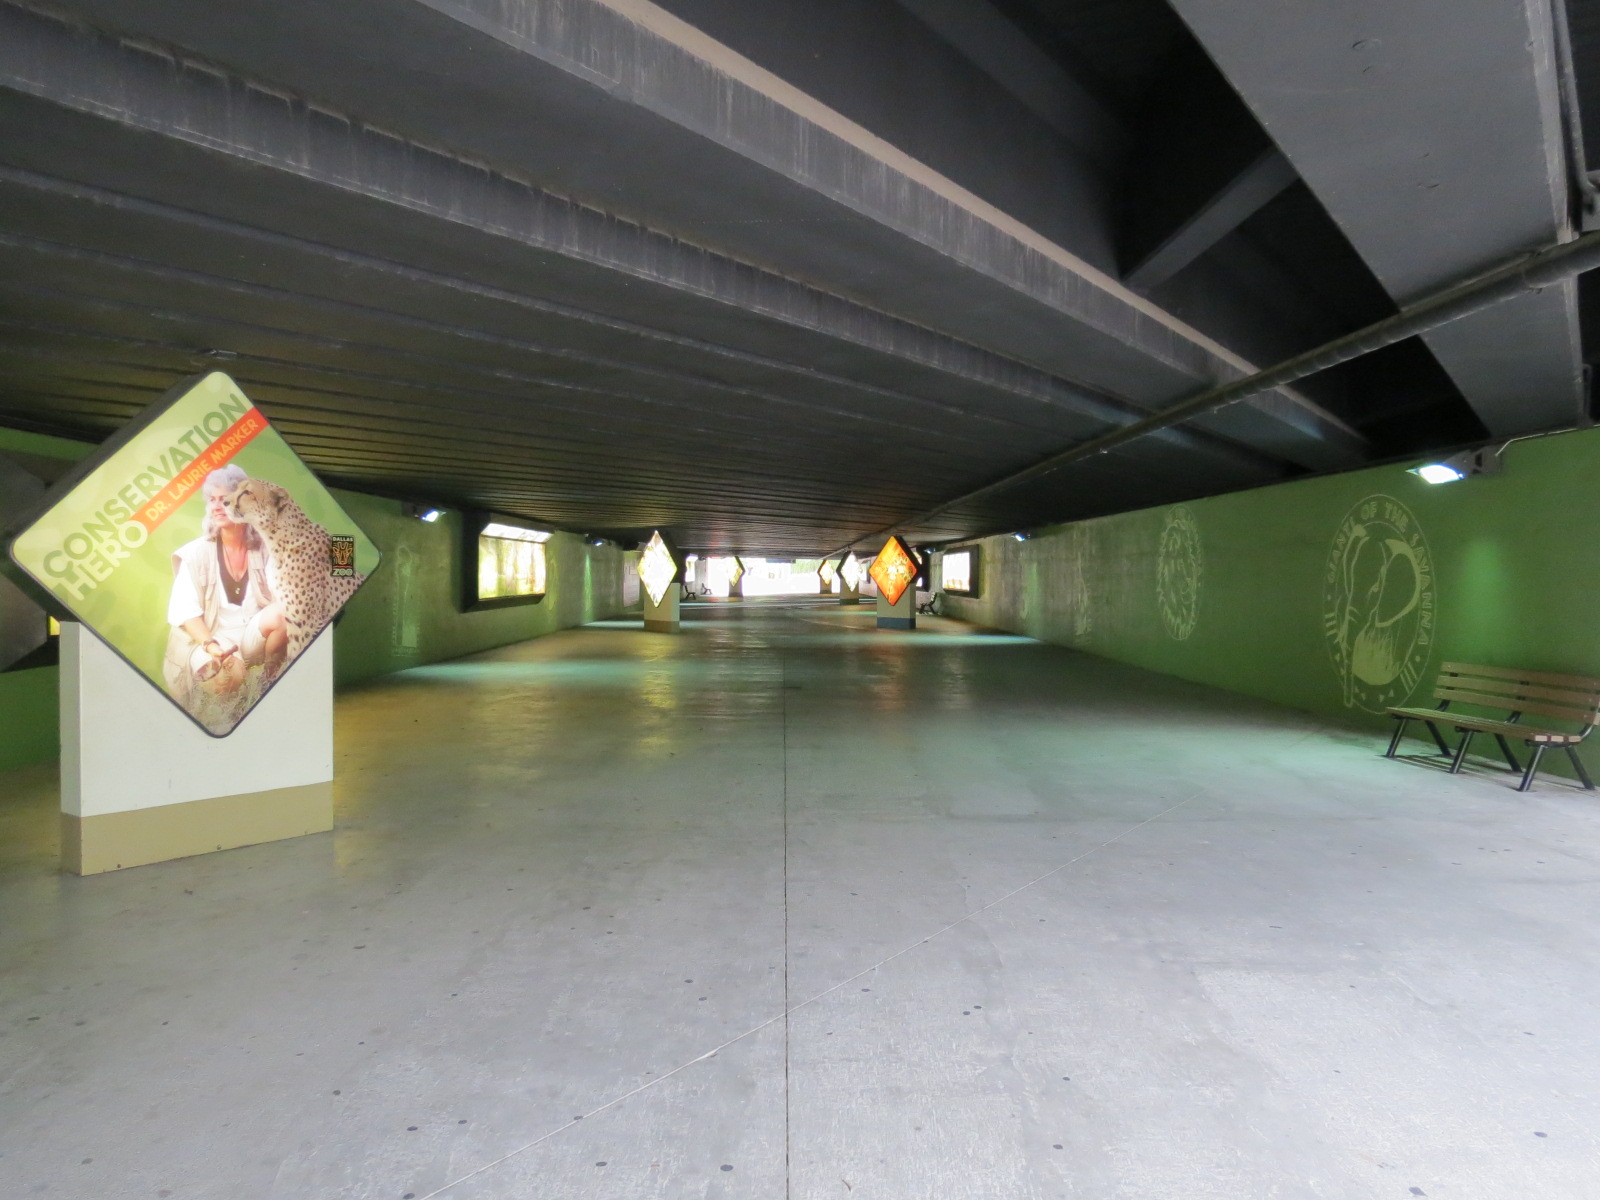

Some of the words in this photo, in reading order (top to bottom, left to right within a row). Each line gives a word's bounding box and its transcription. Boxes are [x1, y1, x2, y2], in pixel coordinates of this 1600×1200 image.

[43, 393, 247, 579] CONSERVATION
[145, 500, 172, 522] DR.
[167, 459, 213, 502] LAURIE
[210, 418, 259, 464] MARKER
[58, 519, 149, 601] HERO
[332, 568, 354, 576] ZOO
[1360, 501, 1378, 520] OF
[1385, 501, 1409, 533] THE
[1409, 533, 1433, 645] SAVANNA
